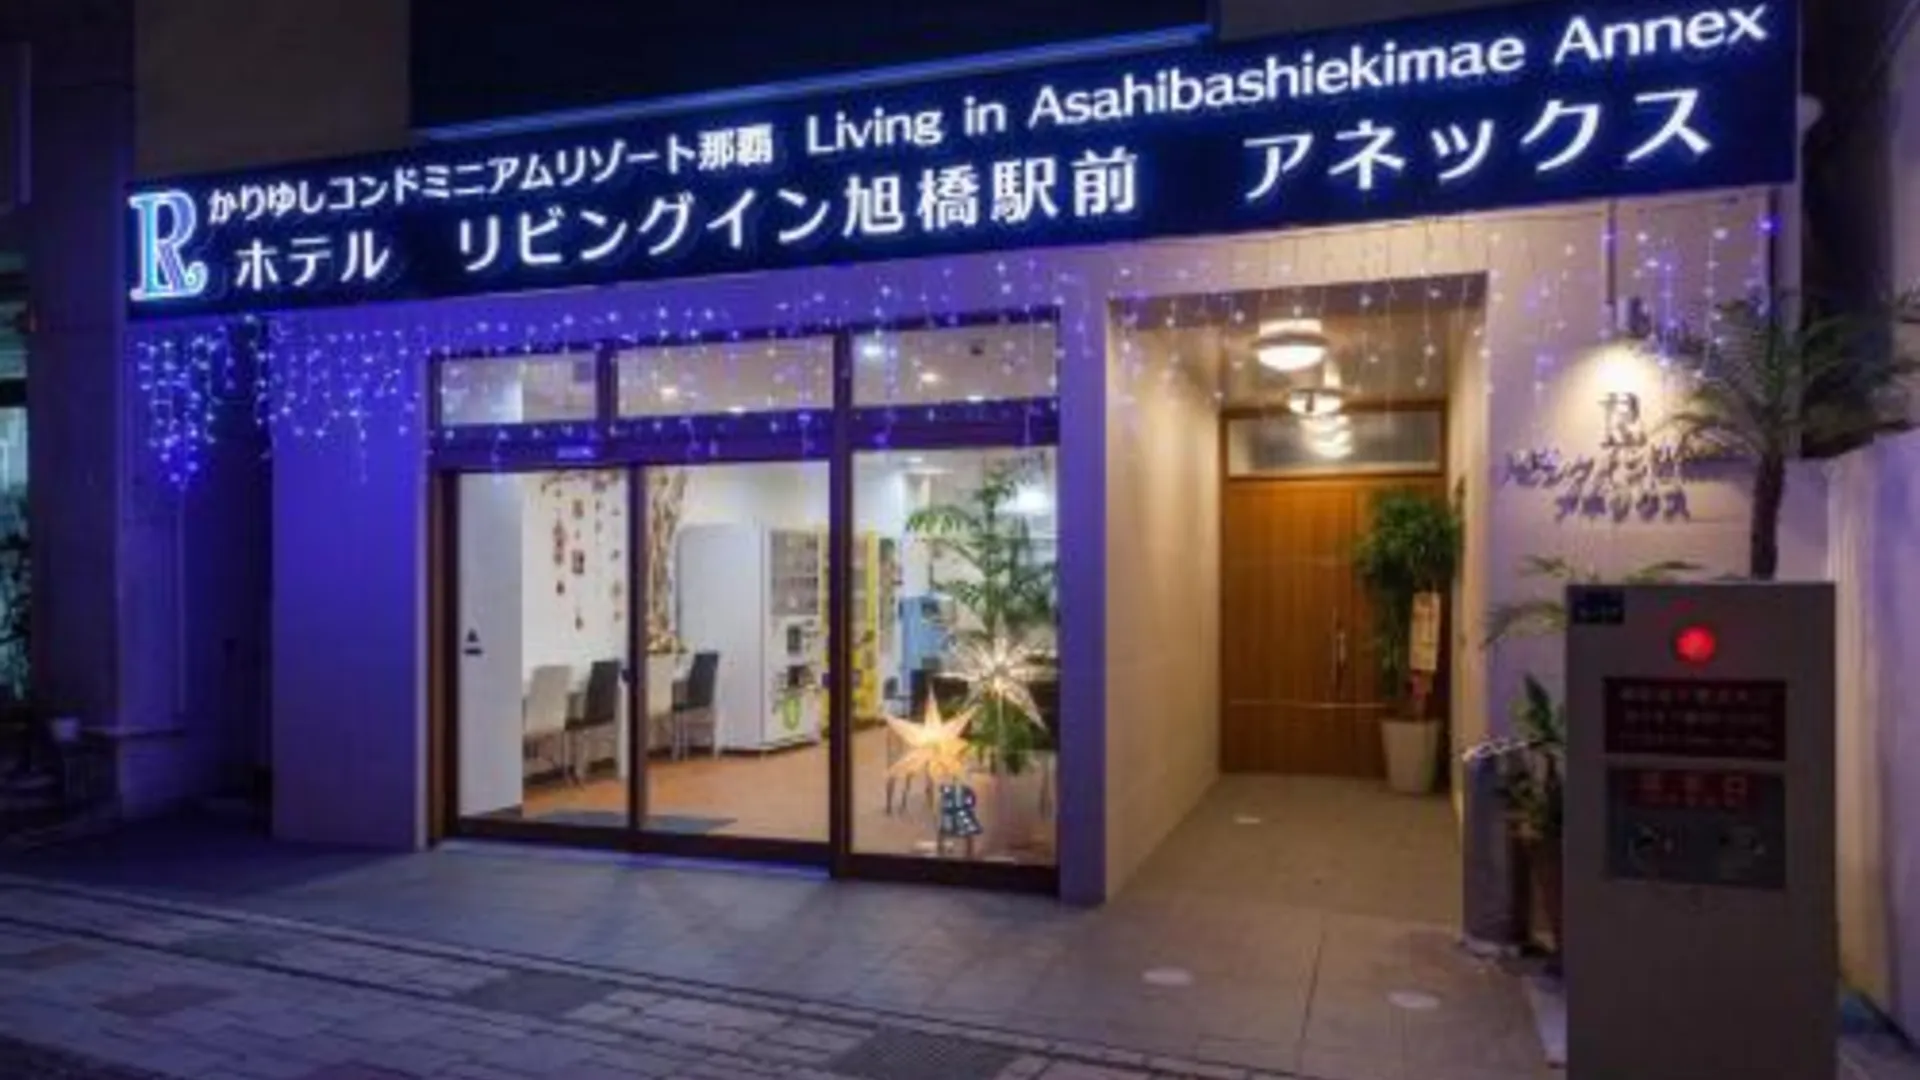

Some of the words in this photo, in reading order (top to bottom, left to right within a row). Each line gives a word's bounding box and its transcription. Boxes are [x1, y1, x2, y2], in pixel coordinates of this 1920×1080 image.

[807, 108, 942, 154] Living
[964, 96, 1005, 136] in
[1028, 37, 1526, 129] Asahibashiekimae
[1554, 5, 1767, 64] Annex
[209, 124, 774, 223] かりゆしコンドミニアムリゾート那覇
[234, 229, 389, 290] ホテル
[456, 149, 1140, 271] リビングイン旭橋駅前
[1243, 87, 1712, 200] アネックス
